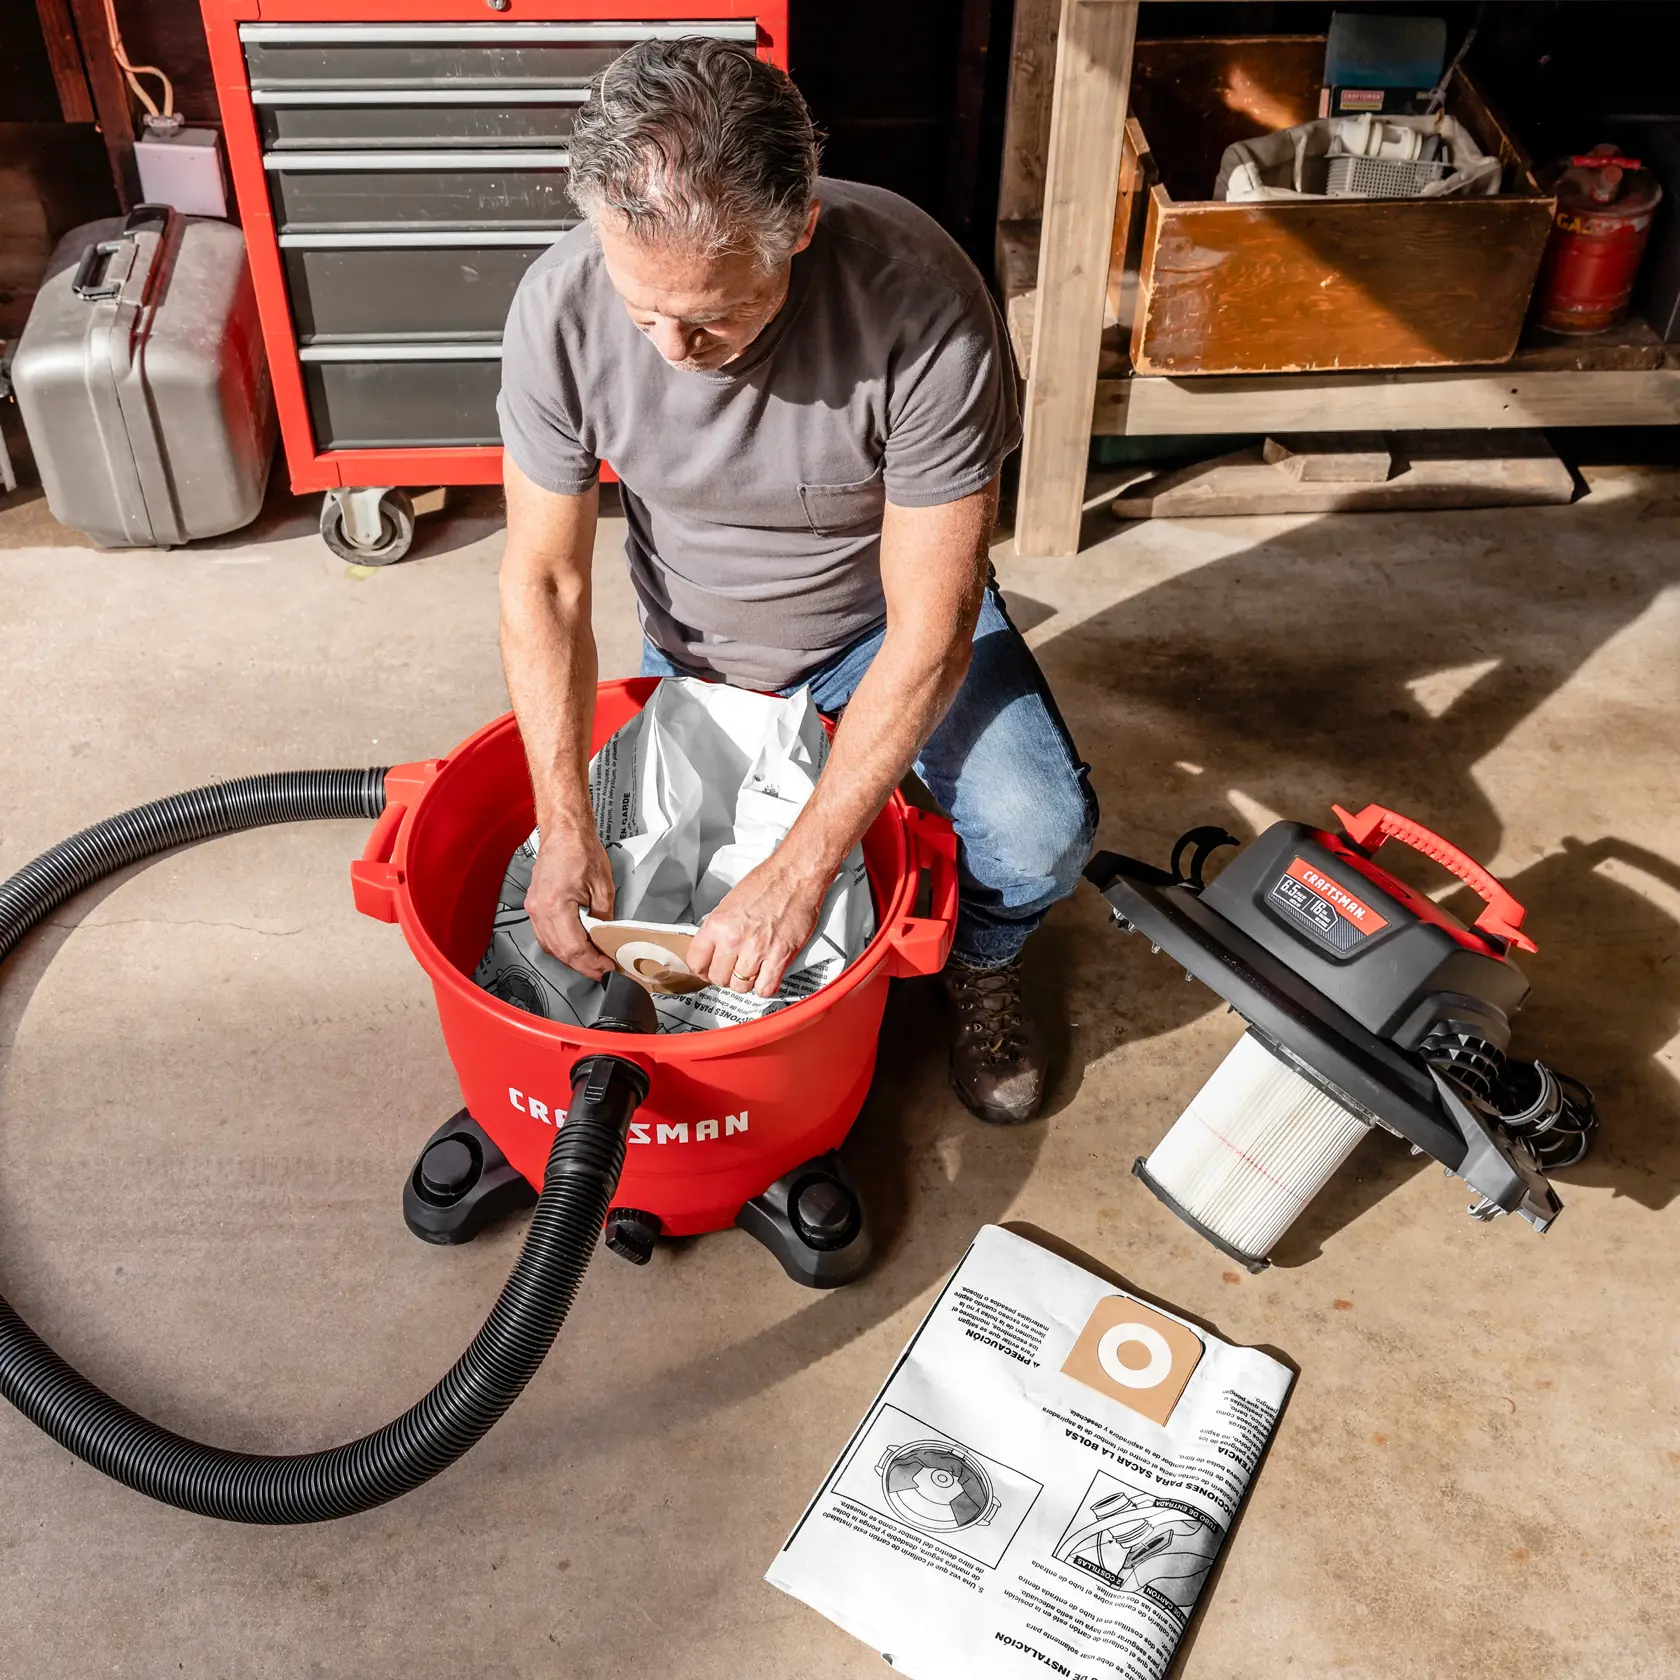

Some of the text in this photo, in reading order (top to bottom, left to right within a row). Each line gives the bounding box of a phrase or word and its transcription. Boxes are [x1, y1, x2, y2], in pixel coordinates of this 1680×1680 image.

[621, 792, 630, 825] GARDE
[1280, 880, 1327, 916] 6.5 16
[1303, 870, 1366, 919] CRAFTSMAN
[693, 1001, 714, 1013] PARA
[953, 1291, 973, 1302] aspire
[961, 1286, 1049, 1331] materiales pesados filosos.
[973, 1299, 997, 1312] cuando
[957, 1316, 979, 1328] salgan
[958, 1309, 990, 1326] monitoree
[980, 1310, 998, 1322] bolsa
[997, 1310, 1020, 1324] exceso
[988, 1330, 1001, 1339] que
[991, 1322, 1027, 1344] escombros,
[1014, 1327, 1041, 1344] volumen
[1030, 1327, 1046, 1338] llene
[965, 1328, 1031, 1365] PRECAUCIÓN
[1001, 1337, 1019, 1348] evitar
[1028, 1342, 1038, 1351] los
[1020, 1346, 1035, 1358] Para
[1042, 1407, 1076, 1426] aspiradora
[1069, 1408, 1102, 1428] deséchela.
[1215, 1409, 1235, 1418] como
[1093, 1433, 1116, 1449] tambor
[1108, 1429, 1144, 1450] aspiradora
[1116, 1446, 1128, 1454] del
[1219, 1440, 1247, 1456] peligros
[1129, 1452, 1150, 1465] centro
[1206, 1459, 1225, 1471] bolsa
[1218, 1446, 1253, 1475] TENCIA
[1065, 1428, 1234, 1519] UCCIONES PARA SACAR LA BOLSA
[1197, 1468, 1214, 1477] filtro
[832, 1506, 851, 1518] bolsa
[840, 1500, 868, 1517] muestra.
[1156, 1499, 1216, 1530] TUBO DE ENTRADA
[822, 1511, 852, 1528] instalado
[858, 1518, 881, 1532] ponga
[877, 1519, 897, 1531] como
[852, 1525, 868, 1534] esté
[868, 1532, 890, 1545] cartón
[886, 1532, 917, 1550] desdoble
[897, 1529, 922, 1544] tambor
[922, 1540, 934, 1548] del
[900, 1548, 926, 1563] collarín
[934, 1546, 957, 1560] dentro
[935, 1564, 948, 1573] que
[944, 1560, 970, 1575] manera
[957, 1557, 974, 1569] filtro
[1031, 1560, 1057, 1577] entrada
[1077, 1558, 1115, 1581] COSTILLAS
[949, 1571, 961, 1580] vez
[962, 1577, 976, 1589] Una
[978, 1585, 984, 1593] 5.
[1068, 1580, 1084, 1592] tubo
[1003, 1589, 1034, 1608] posición
[1020, 1589, 1055, 1610] adecuado.
[1093, 1593, 1113, 1605] sobre
[1144, 1587, 1173, 1609] CARTÓN
[1018, 1575, 1155, 1649] dos costillas tubo de entrada dentro
[1042, 1609, 1052, 1617] en
[1137, 1609, 1147, 1617] de
[1140, 1602, 1151, 1612] las
[1052, 1615, 1068, 1625] esté
[1056, 1608, 1073, 1620] sello
[1026, 1622, 1043, 1633] para
[1068, 1623, 1091, 1639] cartón
[1042, 1631, 1079, 1655] solamente
[994, 1631, 1070, 1677] INSTALACIÓN
[1128, 1650, 1136, 1658] el
